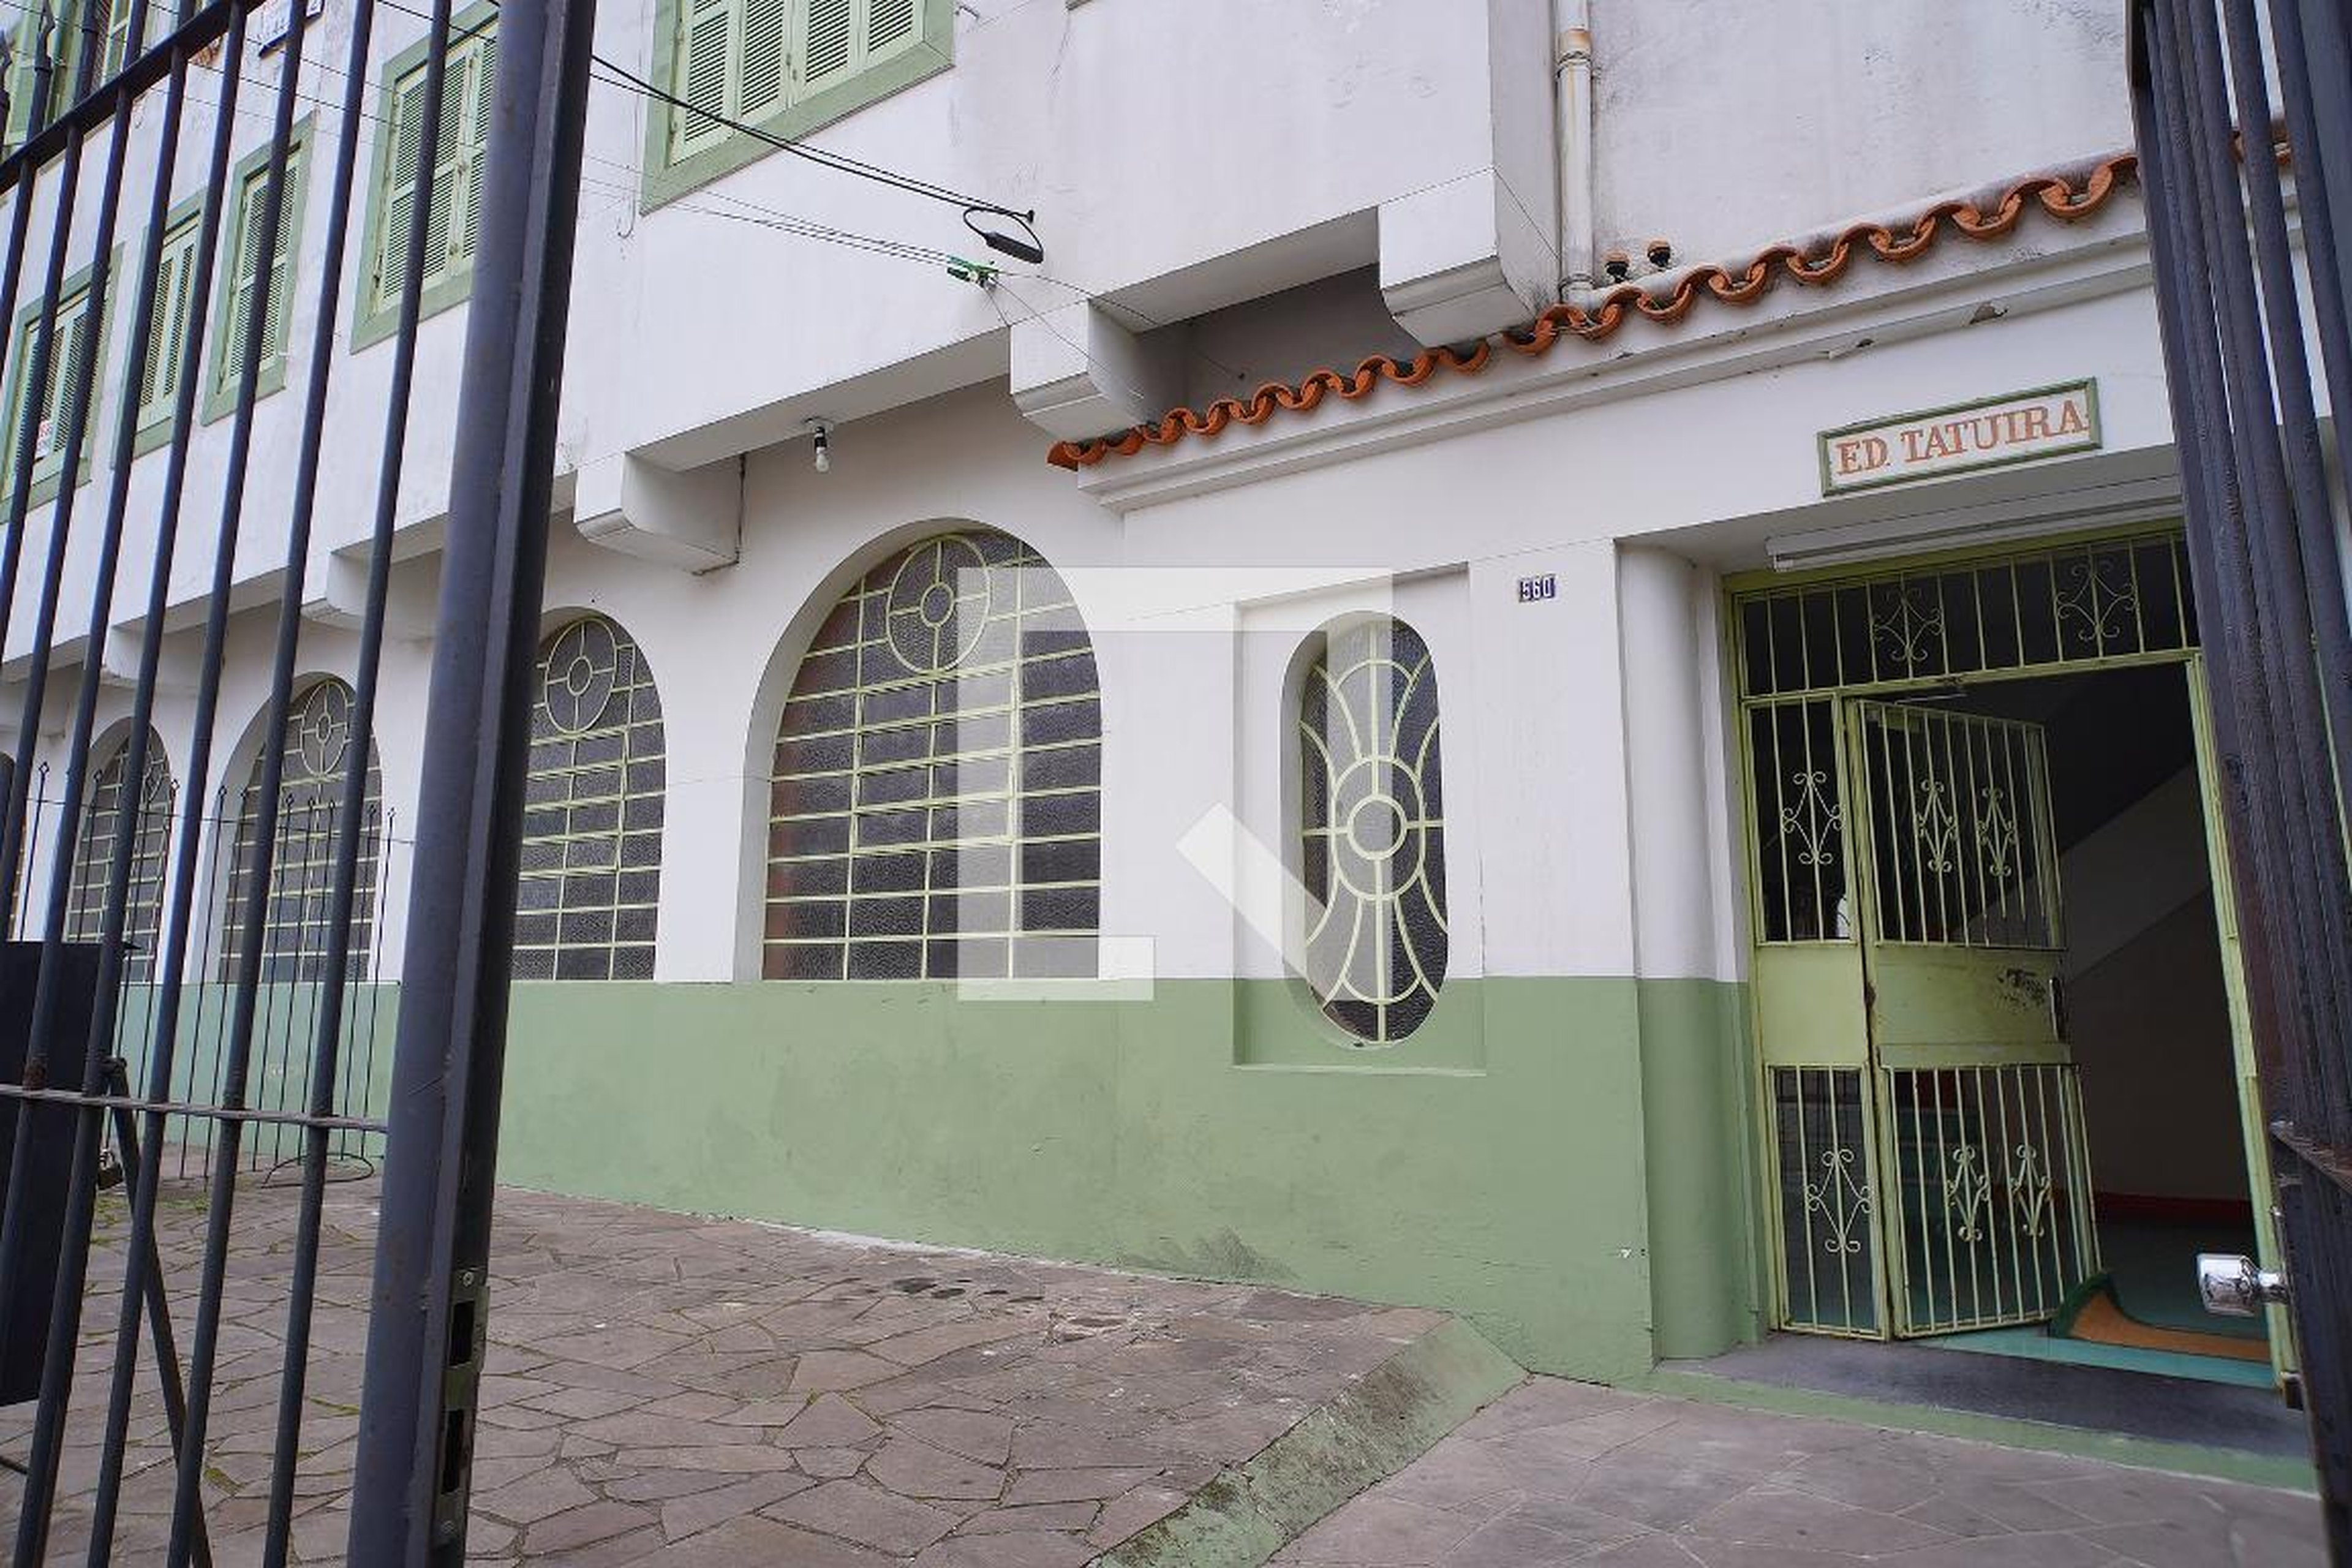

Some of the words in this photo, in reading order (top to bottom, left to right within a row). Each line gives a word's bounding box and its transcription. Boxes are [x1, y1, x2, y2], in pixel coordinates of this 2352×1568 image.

[1836, 436, 1891, 475] ED.
[1900, 399, 2090, 463] TATUIRA
[1522, 577, 1551, 598] 560
